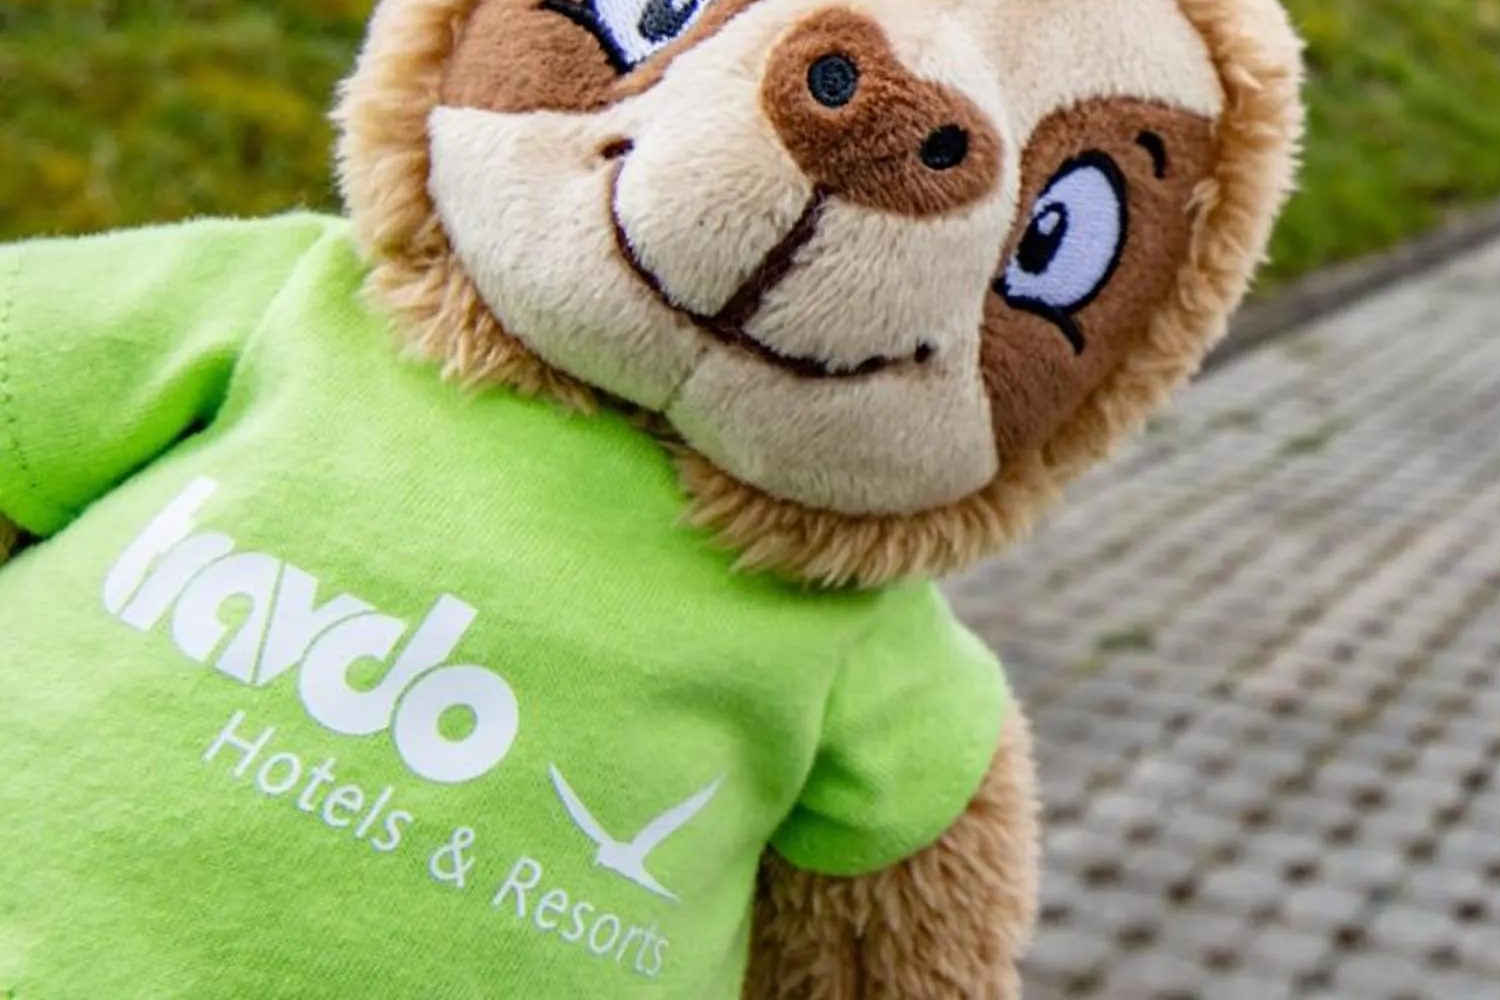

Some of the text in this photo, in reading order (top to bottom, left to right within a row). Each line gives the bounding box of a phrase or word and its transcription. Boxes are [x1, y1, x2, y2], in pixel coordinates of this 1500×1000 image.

[103, 475, 519, 784] travdo
[202, 710, 669, 977] Hotels & Resorts
